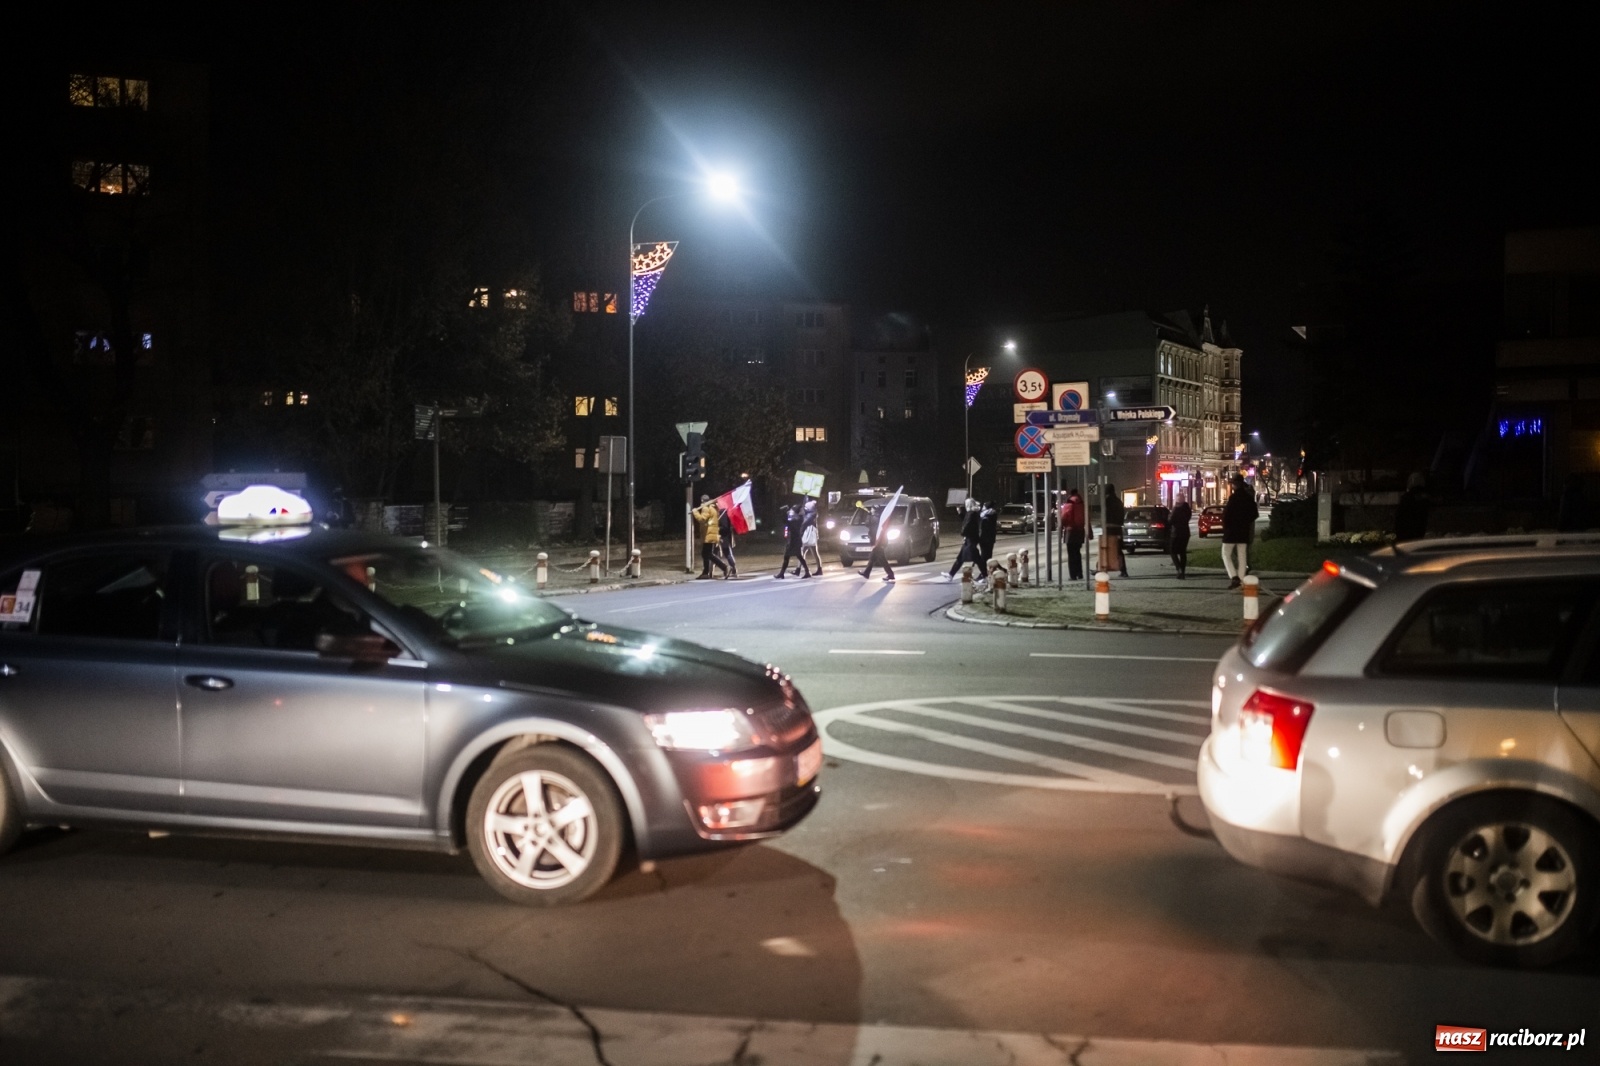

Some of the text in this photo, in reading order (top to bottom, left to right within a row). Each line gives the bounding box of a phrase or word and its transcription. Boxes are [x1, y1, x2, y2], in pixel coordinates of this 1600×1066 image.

[1116, 410, 1136, 420] Wojska
[1138, 410, 1165, 420] Polskiego
[15, 602, 30, 613] 34
